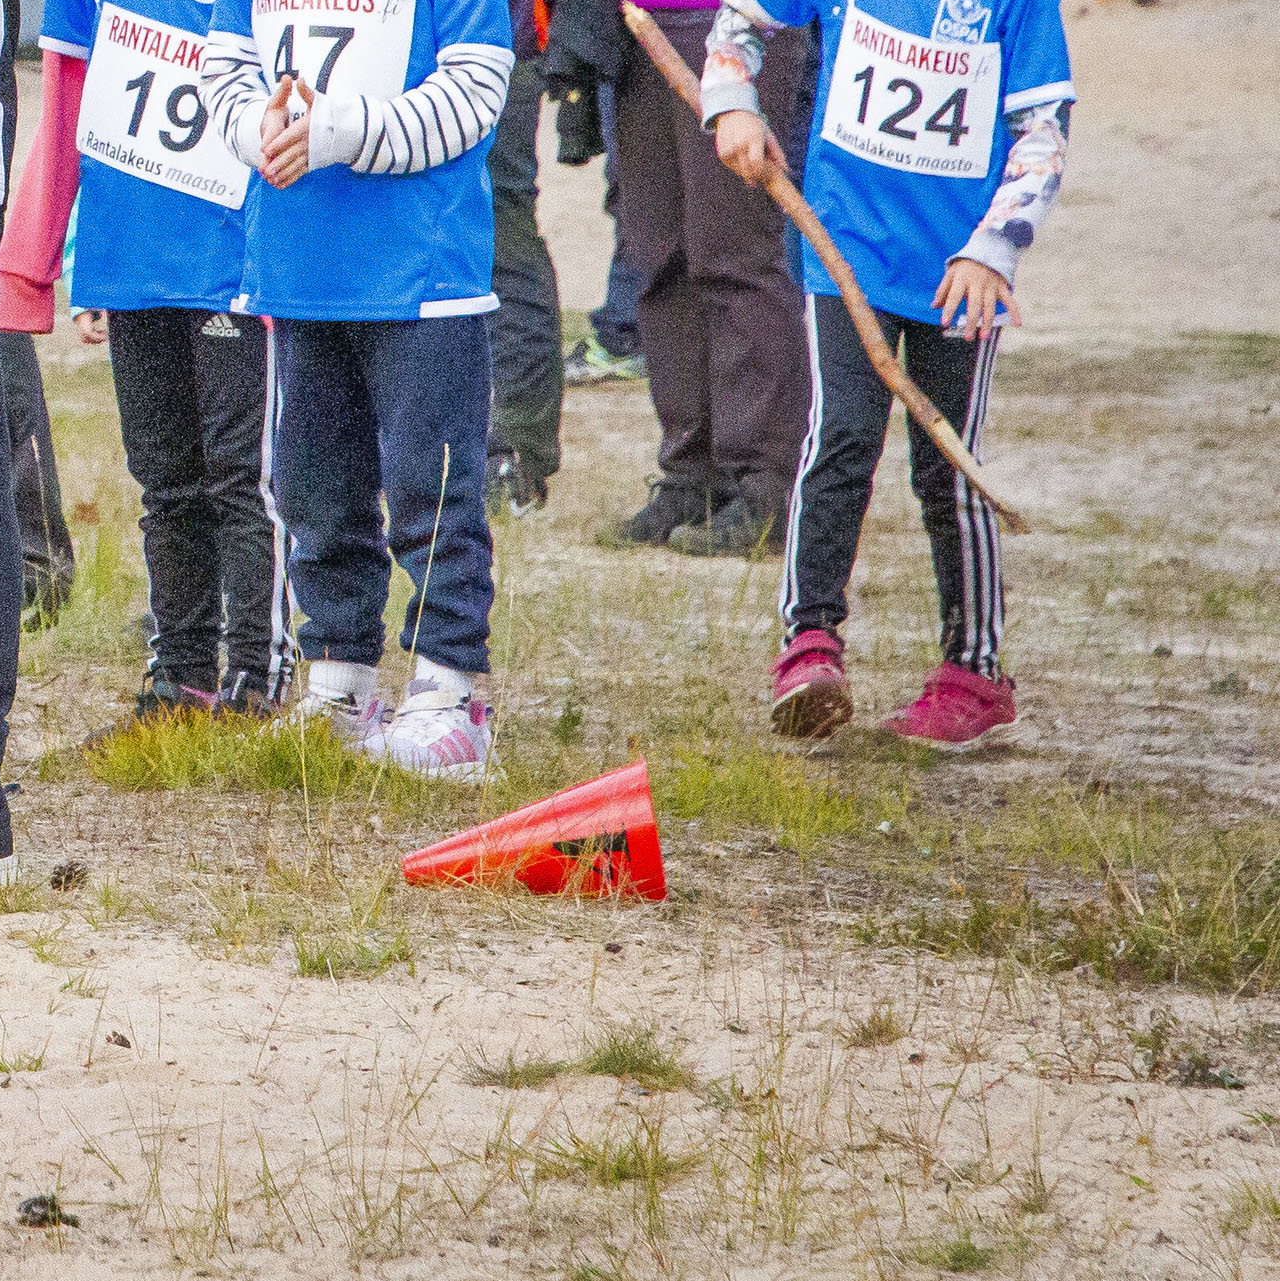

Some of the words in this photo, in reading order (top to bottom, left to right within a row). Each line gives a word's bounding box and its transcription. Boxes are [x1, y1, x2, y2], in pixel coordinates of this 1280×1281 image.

[274, 24, 355, 95] 47
[853, 20, 971, 76] RANTALAKEUS
[125, 70, 209, 153] 19
[854, 65, 970, 147] 124
[86, 131, 163, 176] Rantalakeus
[165, 165, 227, 196] maasto
[836, 123, 912, 164] Rantalakeus
[915, 155, 973, 172] maasto
[202, 325, 242, 338] adidas
